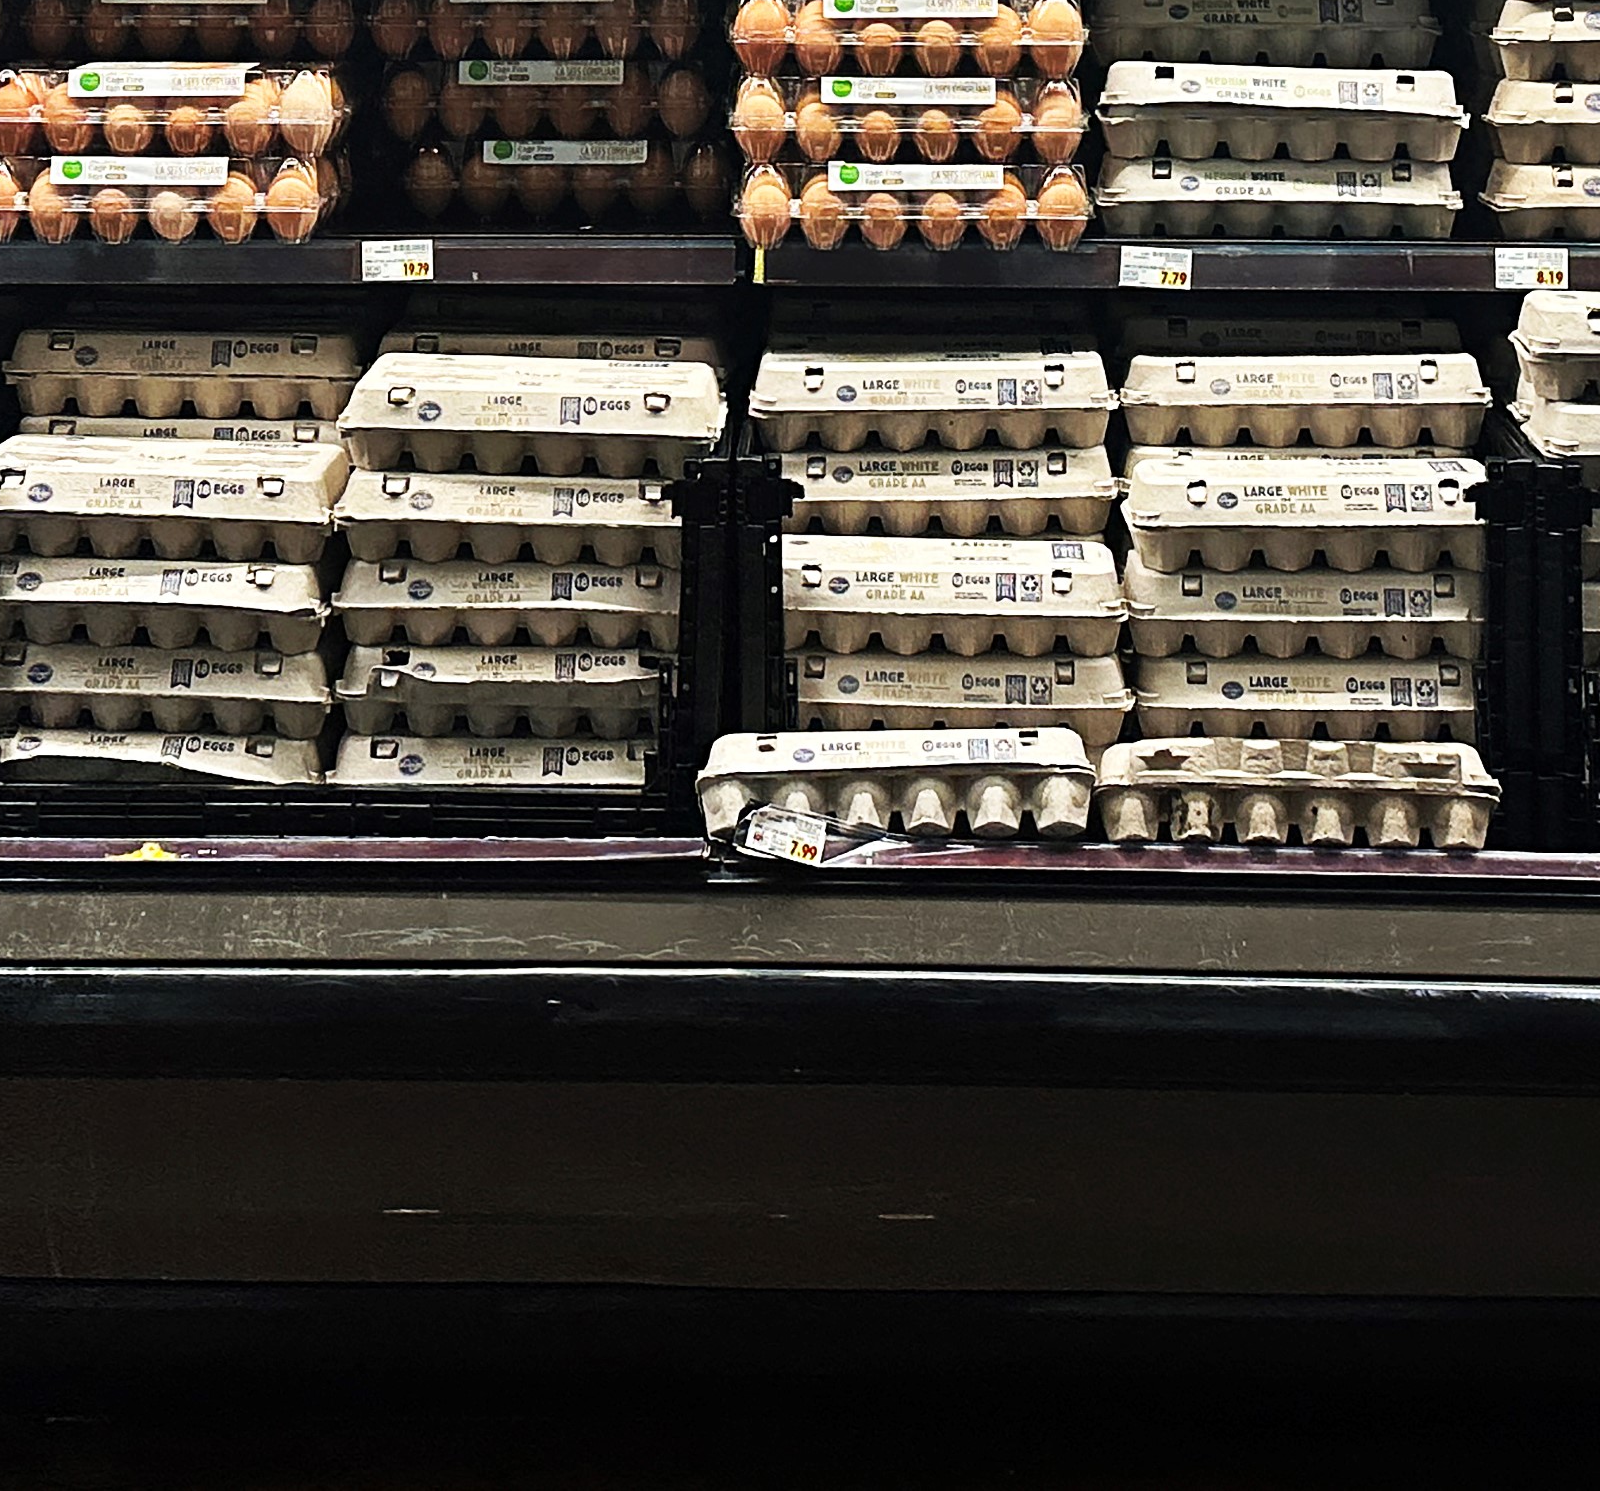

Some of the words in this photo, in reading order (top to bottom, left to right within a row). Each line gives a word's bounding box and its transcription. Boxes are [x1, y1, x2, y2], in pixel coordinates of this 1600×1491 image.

[403, 261, 430, 276] 19.79
[1161, 271, 1188, 286] 7.79
[1536, 270, 1564, 285] 8.19
[859, 460, 898, 472] LARGE
[900, 460, 940, 472] WHITE
[99, 477, 136, 489] LARGE
[213, 483, 245, 496] EGGS
[869, 477, 908, 489] GRADE
[912, 477, 927, 488] AA
[789, 840, 818, 861] 7.99
